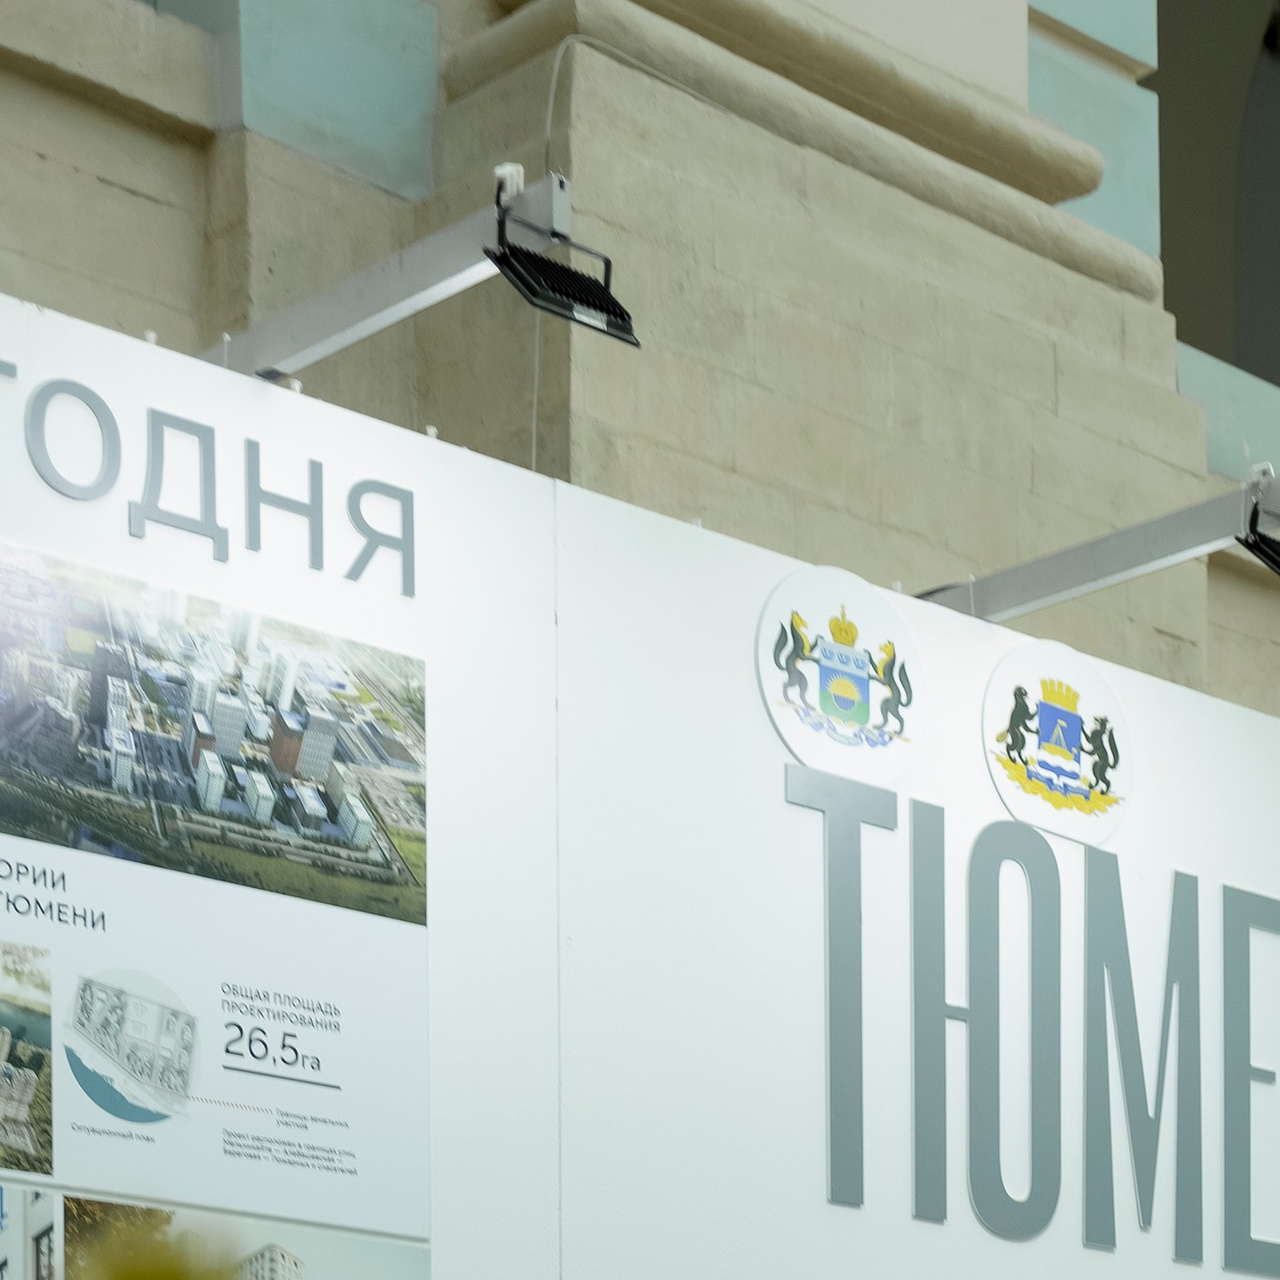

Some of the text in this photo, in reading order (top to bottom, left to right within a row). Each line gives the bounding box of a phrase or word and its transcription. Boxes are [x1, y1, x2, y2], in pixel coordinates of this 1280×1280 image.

[220, 981, 342, 1018] ОБЩАЯ ПЛОЩАДЬ
[220, 998, 342, 1034] ПРОЕКТИРОВАНИЯ
